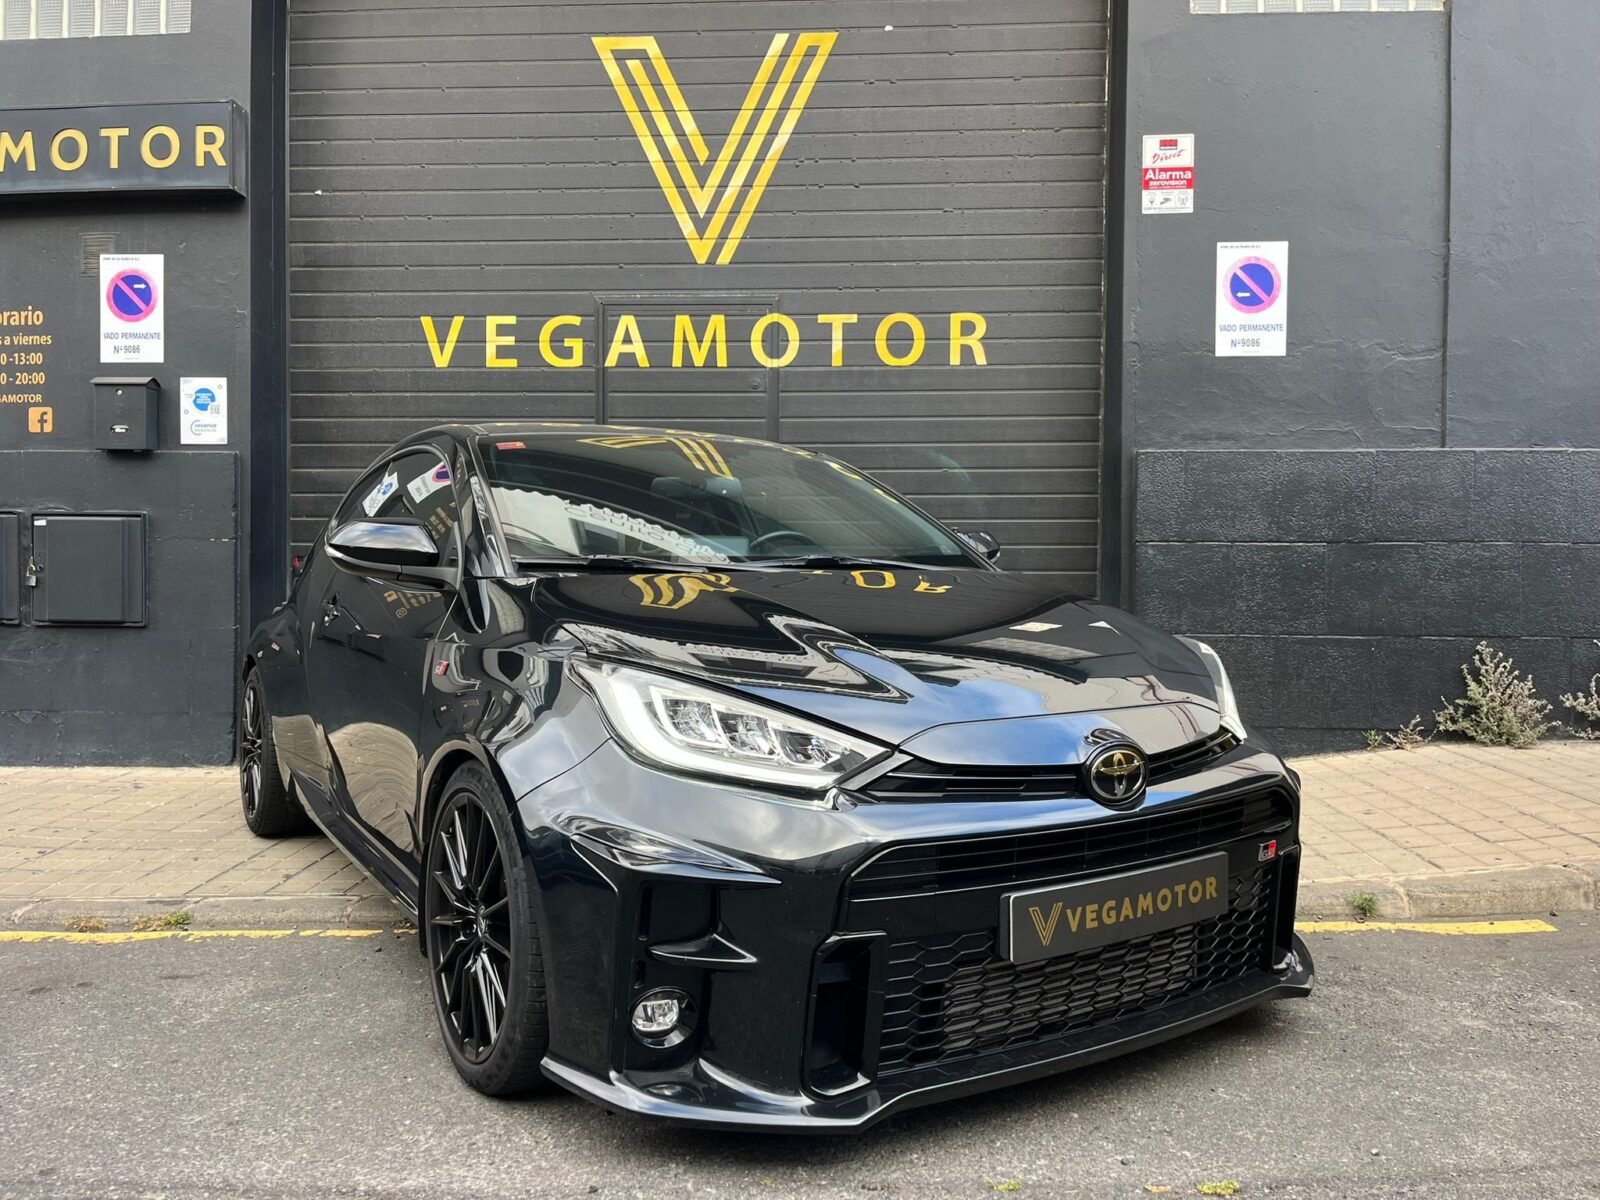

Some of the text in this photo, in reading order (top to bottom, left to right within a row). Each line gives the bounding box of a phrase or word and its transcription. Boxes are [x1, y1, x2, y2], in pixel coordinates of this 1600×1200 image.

[0, 124, 228, 172] MOTOR
[1145, 168, 1192, 180] Alarma
[1219, 324, 1284, 332] VADO PERMANENTE
[4, 335, 11, 346] a
[13, 333, 52, 346] viernes
[103, 332, 161, 341] VADO PERMANENTE
[420, 311, 989, 368] VEGAMOTOR
[15, 372, 45, 385] 20:00
[0, 394, 43, 403] AMOTOR
[1066, 876, 1218, 932] VEGAMOTOR
